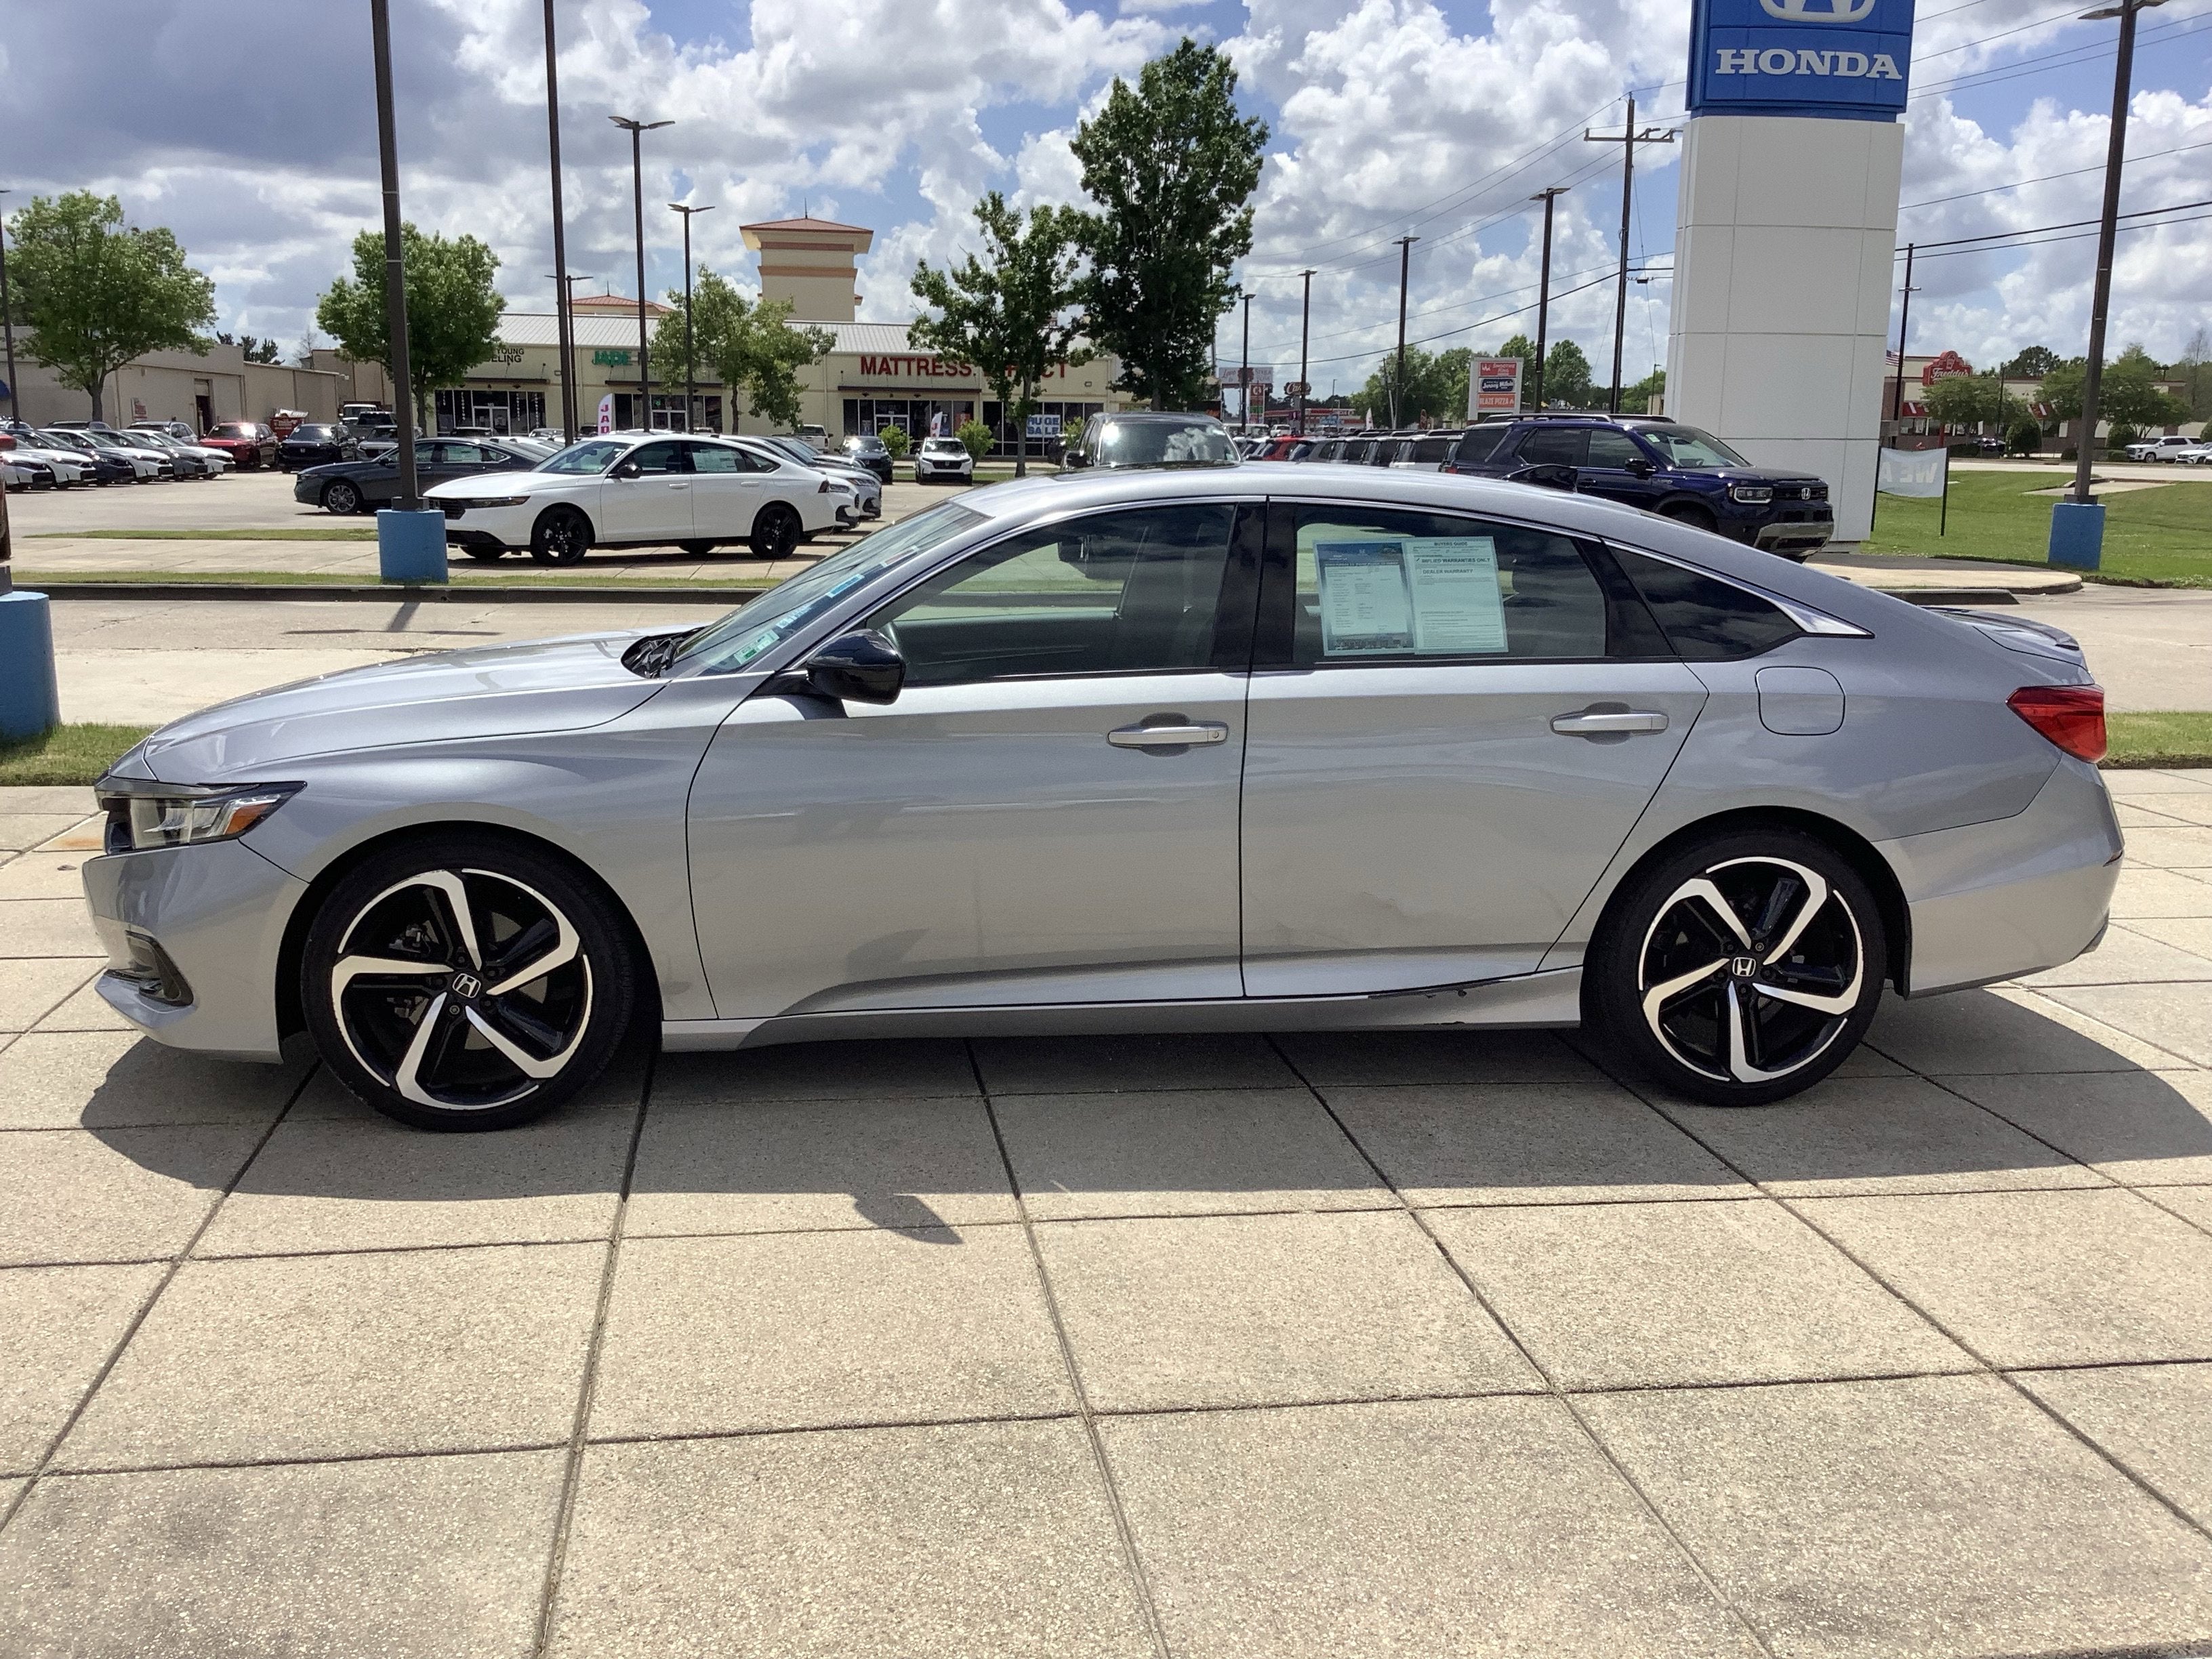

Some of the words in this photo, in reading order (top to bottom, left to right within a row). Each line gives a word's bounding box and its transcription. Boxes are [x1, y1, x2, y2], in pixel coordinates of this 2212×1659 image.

[1715, 48, 1902, 80] HONDA
[861, 356, 972, 377] MATTRESS
[1931, 367, 1969, 379] Freddy's
[1494, 397, 1509, 405] PIZZA
[1027, 426, 1059, 435] SALE
